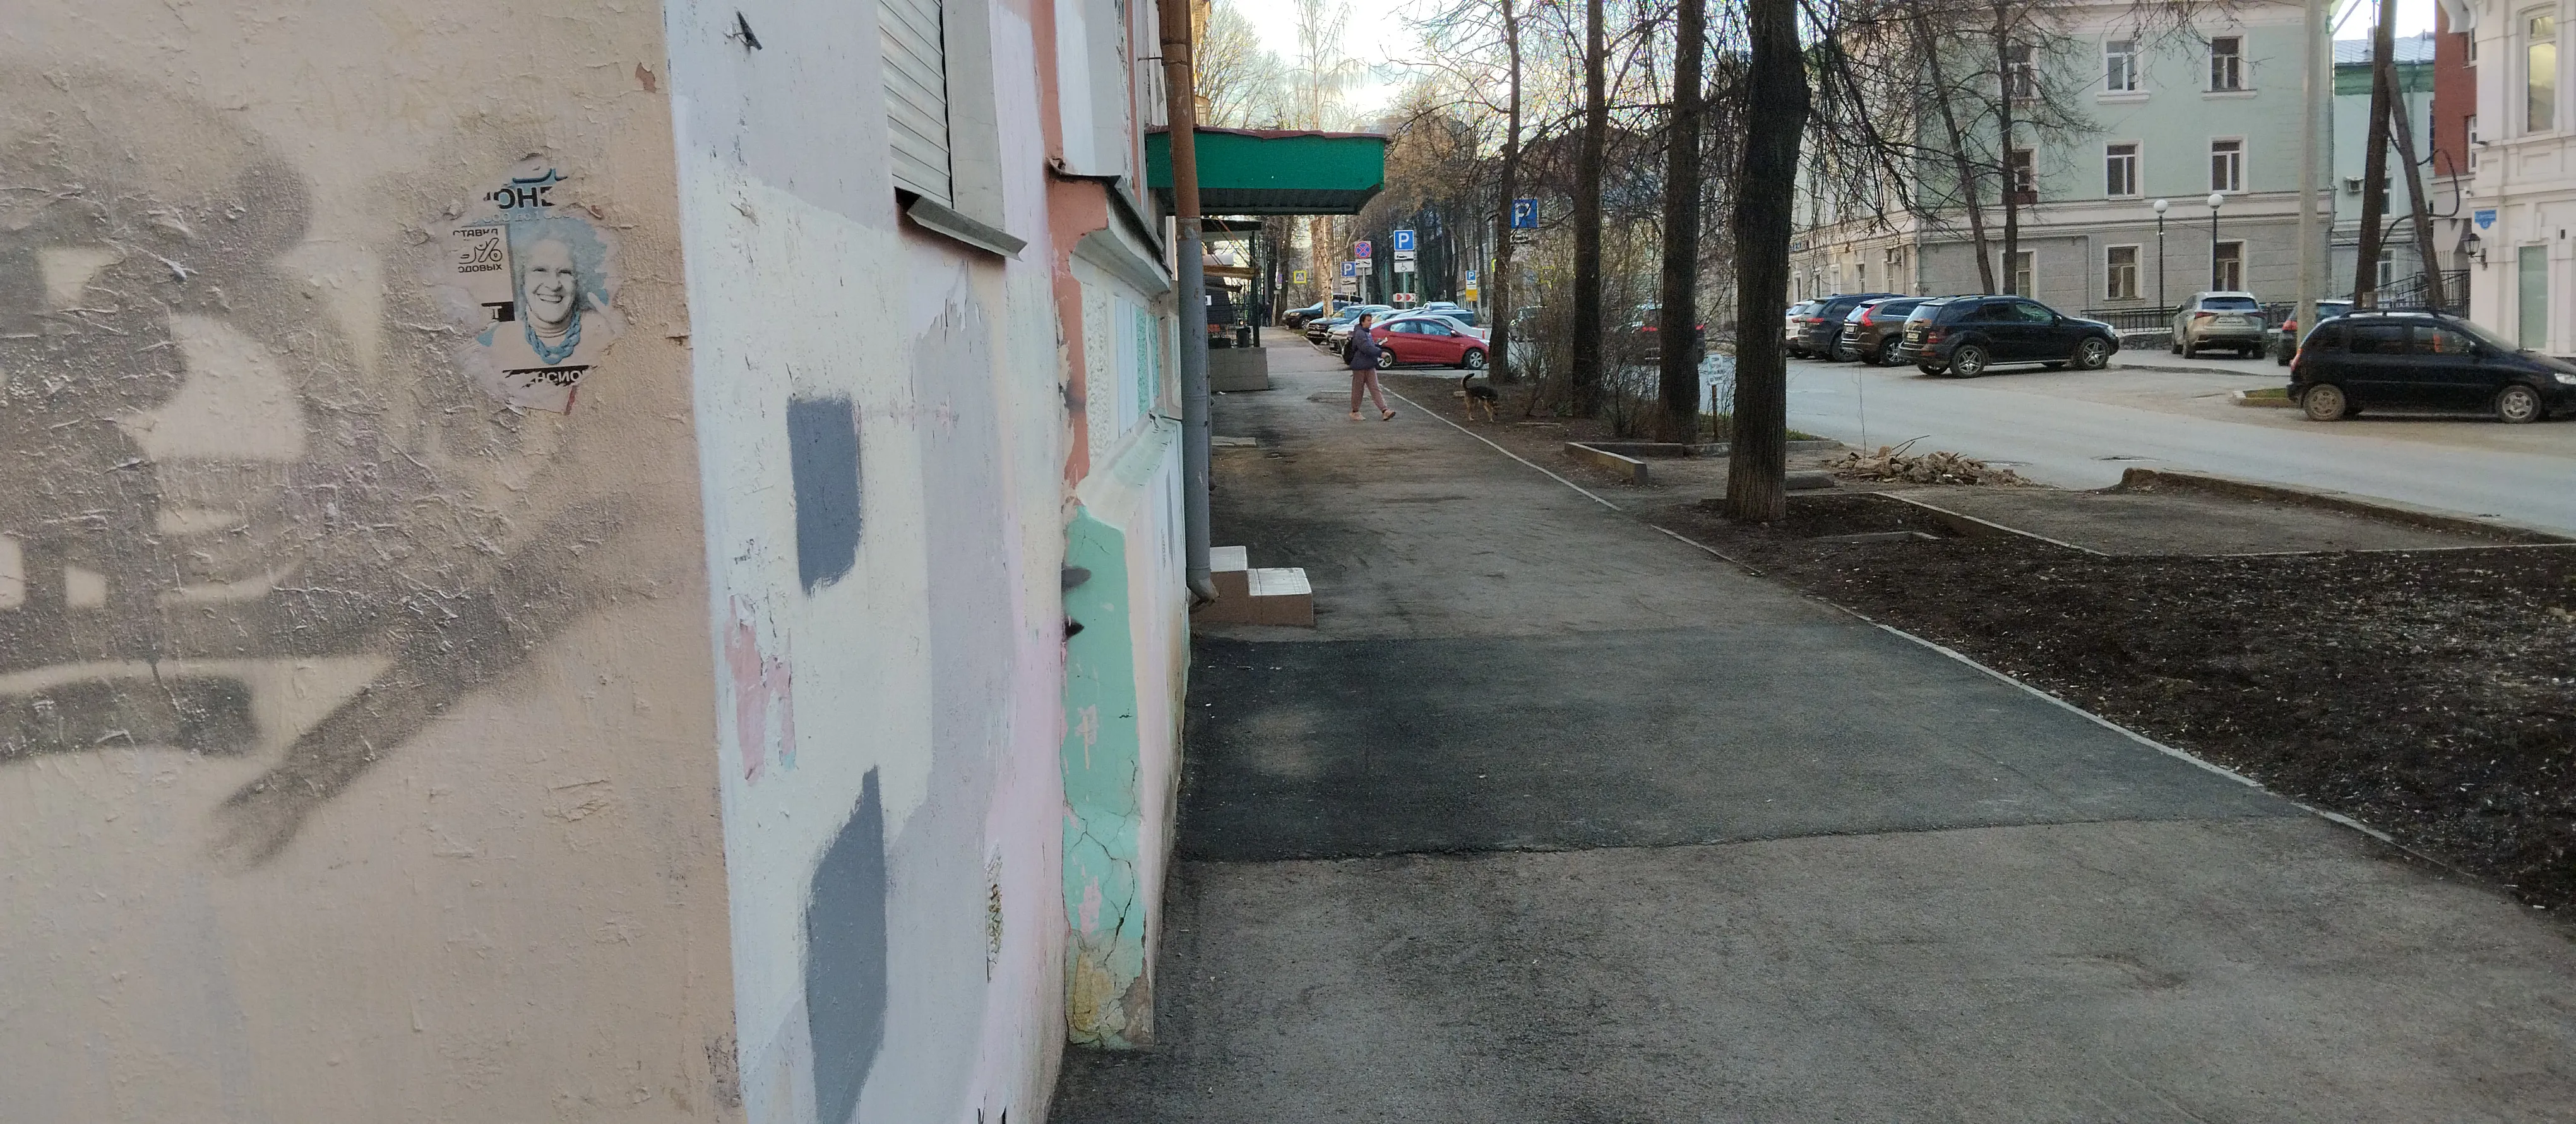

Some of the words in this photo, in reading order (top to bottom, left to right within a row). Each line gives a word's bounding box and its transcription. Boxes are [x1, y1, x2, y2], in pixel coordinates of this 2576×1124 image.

[1515, 202, 1531, 226] P
[1399, 232, 1410, 248] P
[1344, 263, 1352, 275] P
[1468, 272, 1474, 280] P
